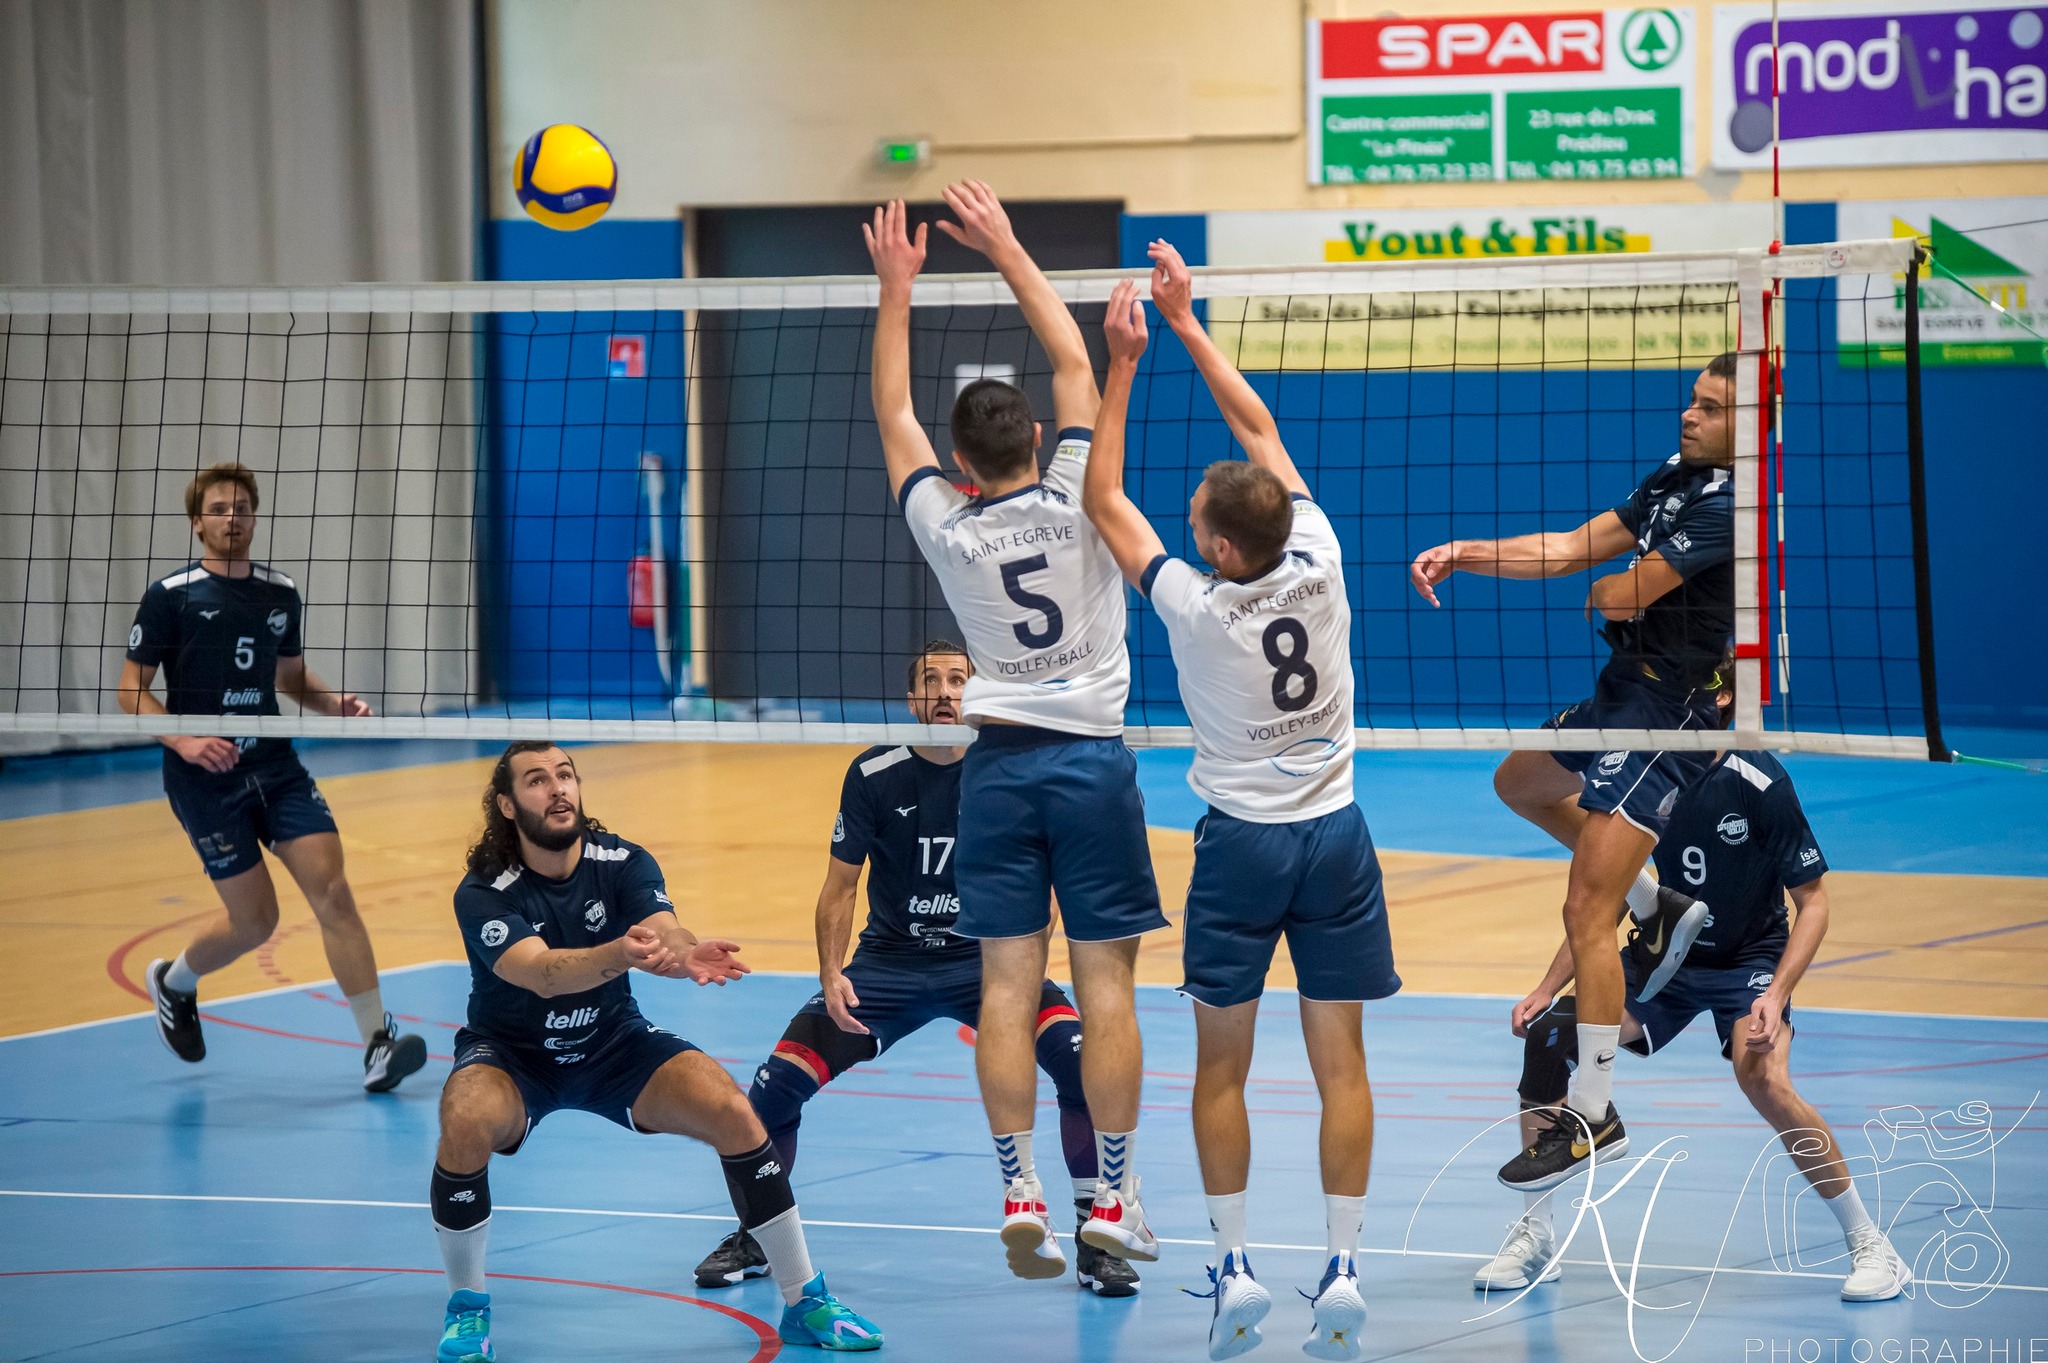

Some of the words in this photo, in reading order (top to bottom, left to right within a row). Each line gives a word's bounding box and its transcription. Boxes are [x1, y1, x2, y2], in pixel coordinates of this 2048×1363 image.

[1378, 19, 1601, 70] SPAR
[1325, 114, 1386, 133] Centre
[1386, 110, 1490, 131] commercial
[1529, 109, 1552, 128] 23
[1553, 112, 1586, 128] rue
[1586, 107, 1613, 127] du
[1343, 221, 1465, 256] Vout
[1482, 219, 1518, 254] &
[1531, 218, 1626, 253] Fils
[961, 525, 1074, 565] SAINT-EGREVE
[998, 552, 1064, 650] 5
[1222, 580, 1326, 631] SAINT-EGREVE
[234, 636, 255, 670] 5
[996, 641, 1094, 676] VOLLEY-BALL
[1262, 616, 1318, 712] 8
[1247, 696, 1340, 741] VOLLEY-BALL
[918, 837, 955, 875] 17
[1682, 845, 1707, 886] 9
[908, 893, 961, 915] tellis
[545, 1006, 600, 1029] tellis
